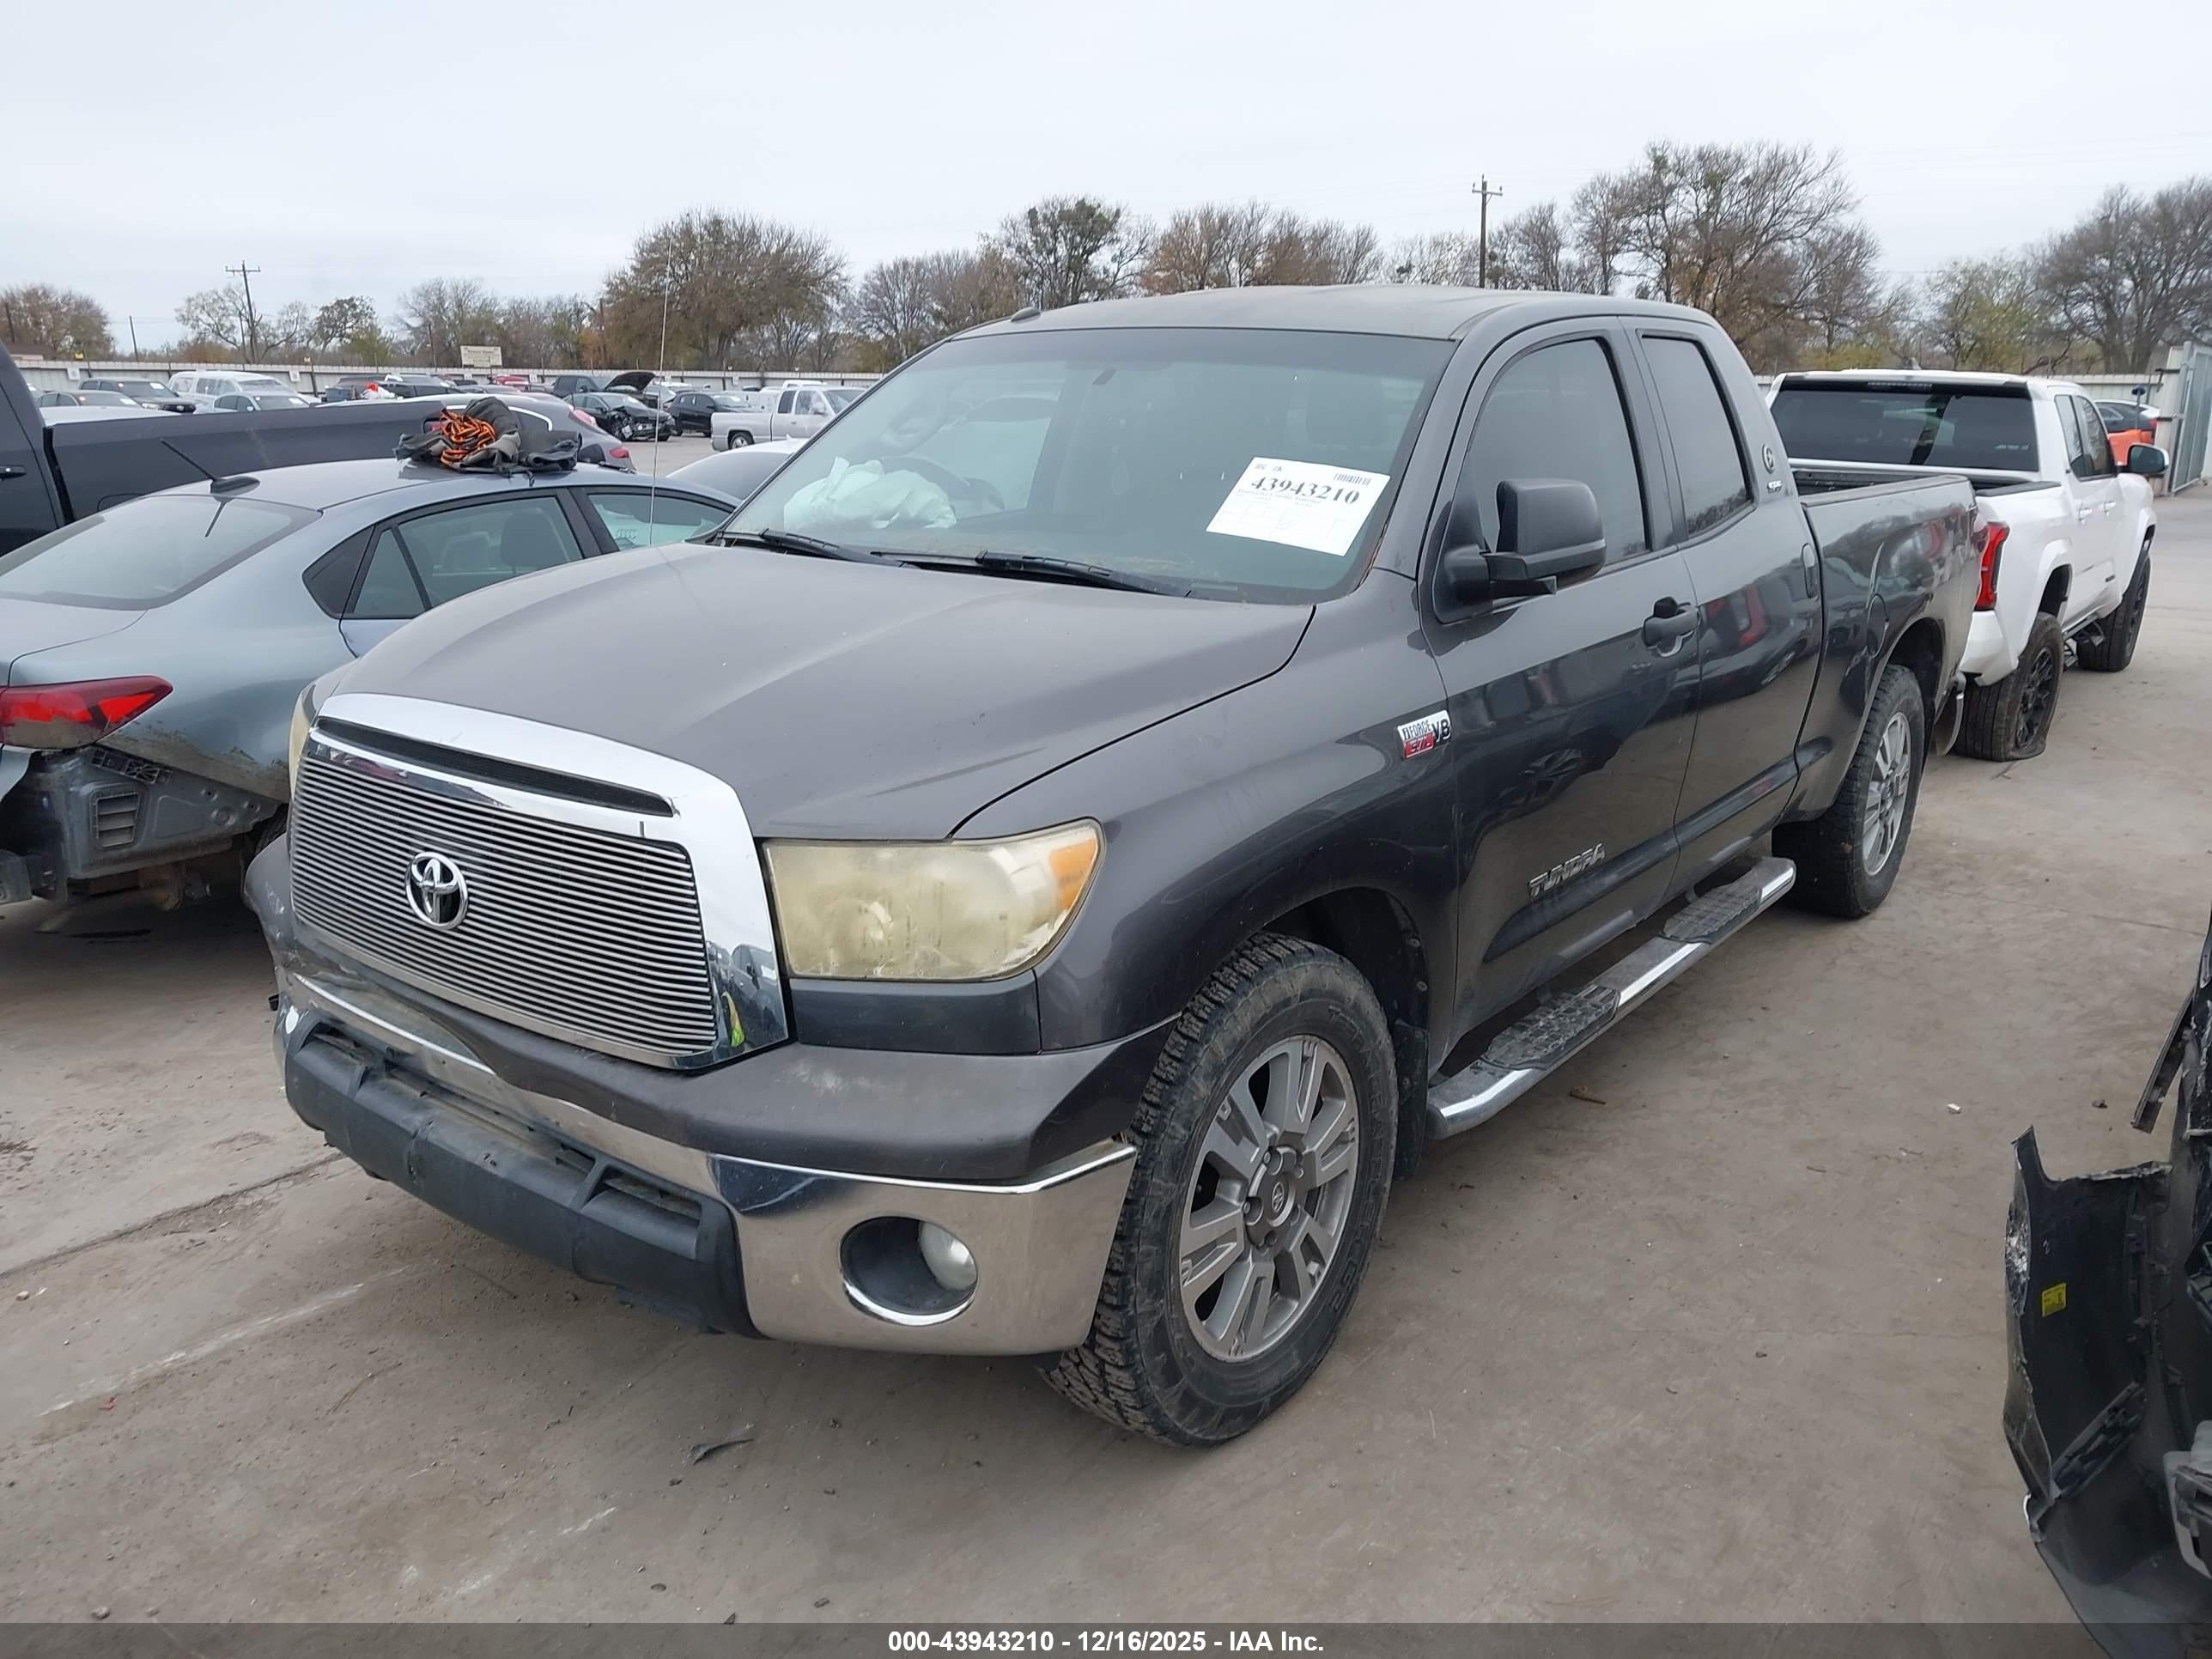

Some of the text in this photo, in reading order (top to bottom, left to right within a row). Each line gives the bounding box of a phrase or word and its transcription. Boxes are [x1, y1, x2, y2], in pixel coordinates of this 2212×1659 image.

[1250, 476, 1360, 504] 43943210
[1431, 718, 1451, 743] V8
[1528, 842, 1607, 897] TUNDRA
